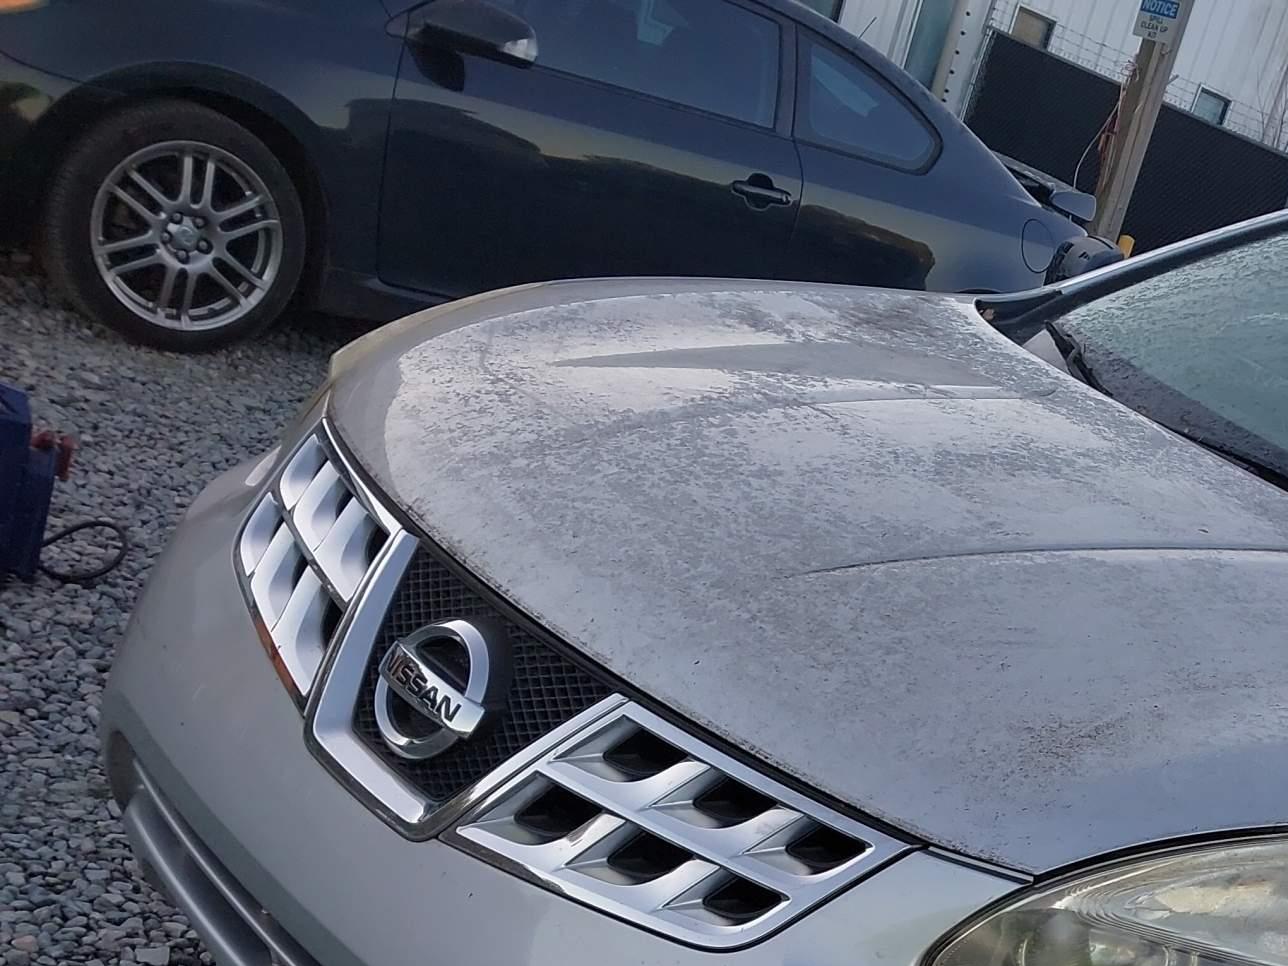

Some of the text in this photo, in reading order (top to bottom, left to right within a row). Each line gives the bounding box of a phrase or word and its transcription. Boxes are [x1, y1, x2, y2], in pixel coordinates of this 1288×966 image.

[1142, 0, 1179, 16] NOTICE
[1140, 20, 1159, 30] CLEAN
[385, 644, 463, 723] NISSAN
